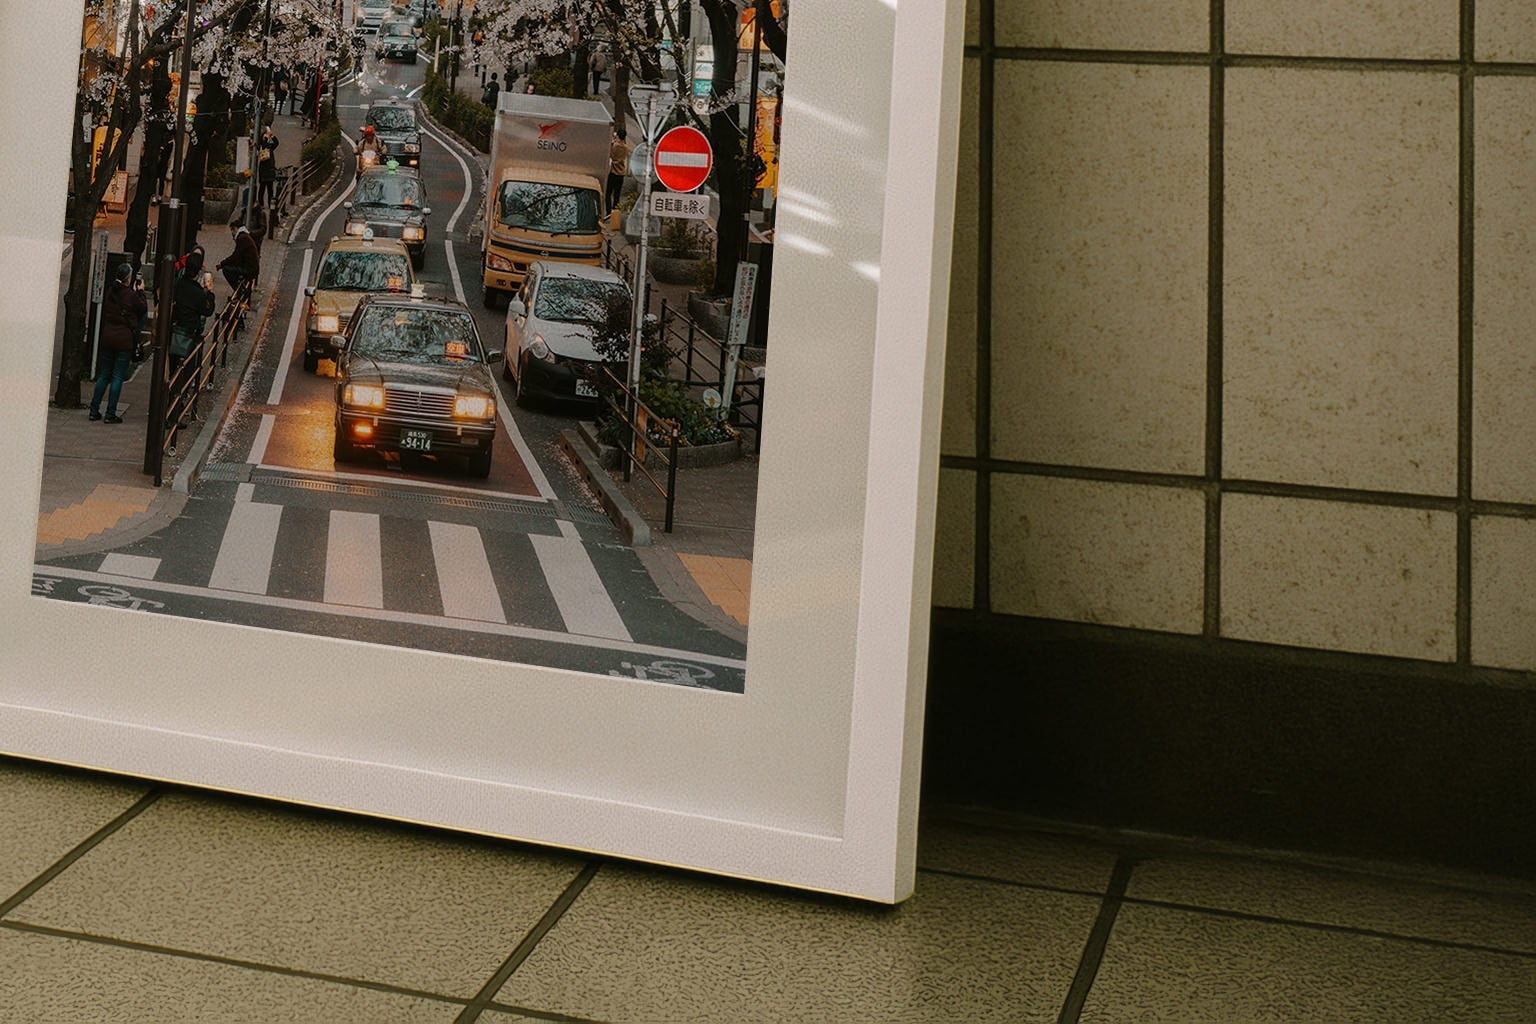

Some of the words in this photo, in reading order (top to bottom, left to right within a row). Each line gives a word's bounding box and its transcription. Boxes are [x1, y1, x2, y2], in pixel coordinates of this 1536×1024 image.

[537, 139, 568, 153] SEINO
[654, 197, 705, 215] 自転車を除く
